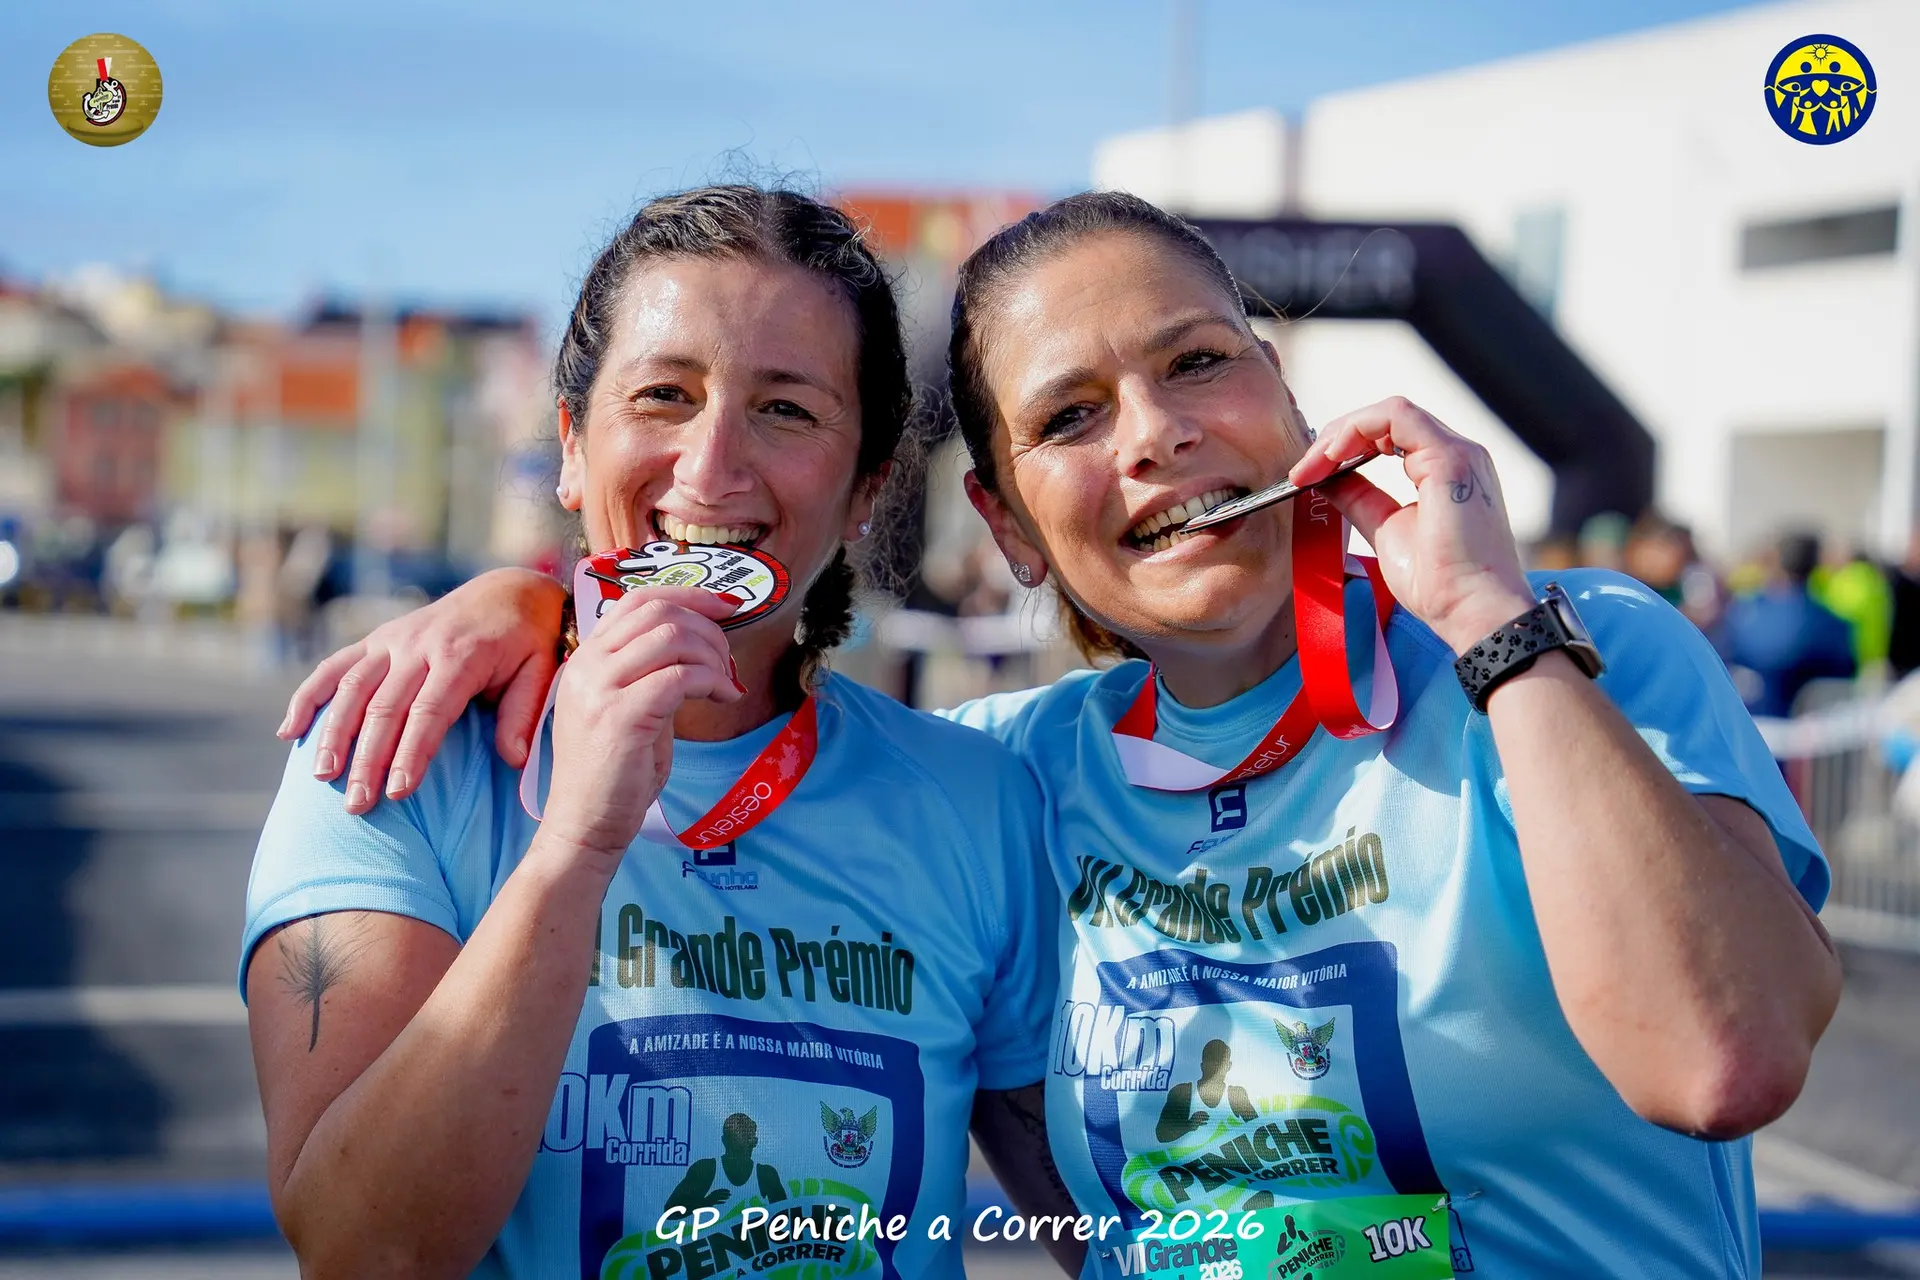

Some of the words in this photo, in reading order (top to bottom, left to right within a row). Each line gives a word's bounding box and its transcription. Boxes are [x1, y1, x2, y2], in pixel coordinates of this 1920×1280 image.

[704, 566, 754, 591] Prémio
[696, 782, 772, 844] oestetur
[1114, 867, 1242, 944] Grande
[1242, 825, 1390, 941] Prémio
[617, 903, 766, 1001] Grande
[768, 925, 914, 1016] Prémio
[1126, 976, 1136, 990] A
[1140, 966, 1182, 990] AMIZADE
[1181, 963, 1191, 982] É
[1192, 965, 1200, 980] A
[1202, 965, 1250, 984] NOSSA
[1253, 974, 1298, 990] MAIOR
[1301, 963, 1348, 986] VITÓRIA
[628, 1038, 640, 1054] A
[644, 1033, 710, 1052] AMIZADE
[712, 1030, 722, 1050] É
[724, 1034, 735, 1050] A
[738, 1035, 784, 1055] NOSSA
[787, 1041, 834, 1059] MAIOR
[834, 1046, 884, 1070] VITÓRIA
[1054, 1000, 1176, 1077] 10Km
[1100, 1064, 1170, 1091] Corrida
[538, 1072, 692, 1153] 0Km
[605, 1136, 690, 1166] Corrida
[1158, 1118, 1333, 1204] PENICHE
[1254, 1158, 1340, 1180] CORRER
[752, 1244, 847, 1272] CORRER
[1112, 1242, 1146, 1276] VII
[1145, 1238, 1238, 1272] Grande
[1277, 1237, 1333, 1280] PENICHE
[1361, 1216, 1432, 1263] 10K
[1200, 1258, 1244, 1280] 2026
[1308, 1252, 1334, 1267] CORRER
